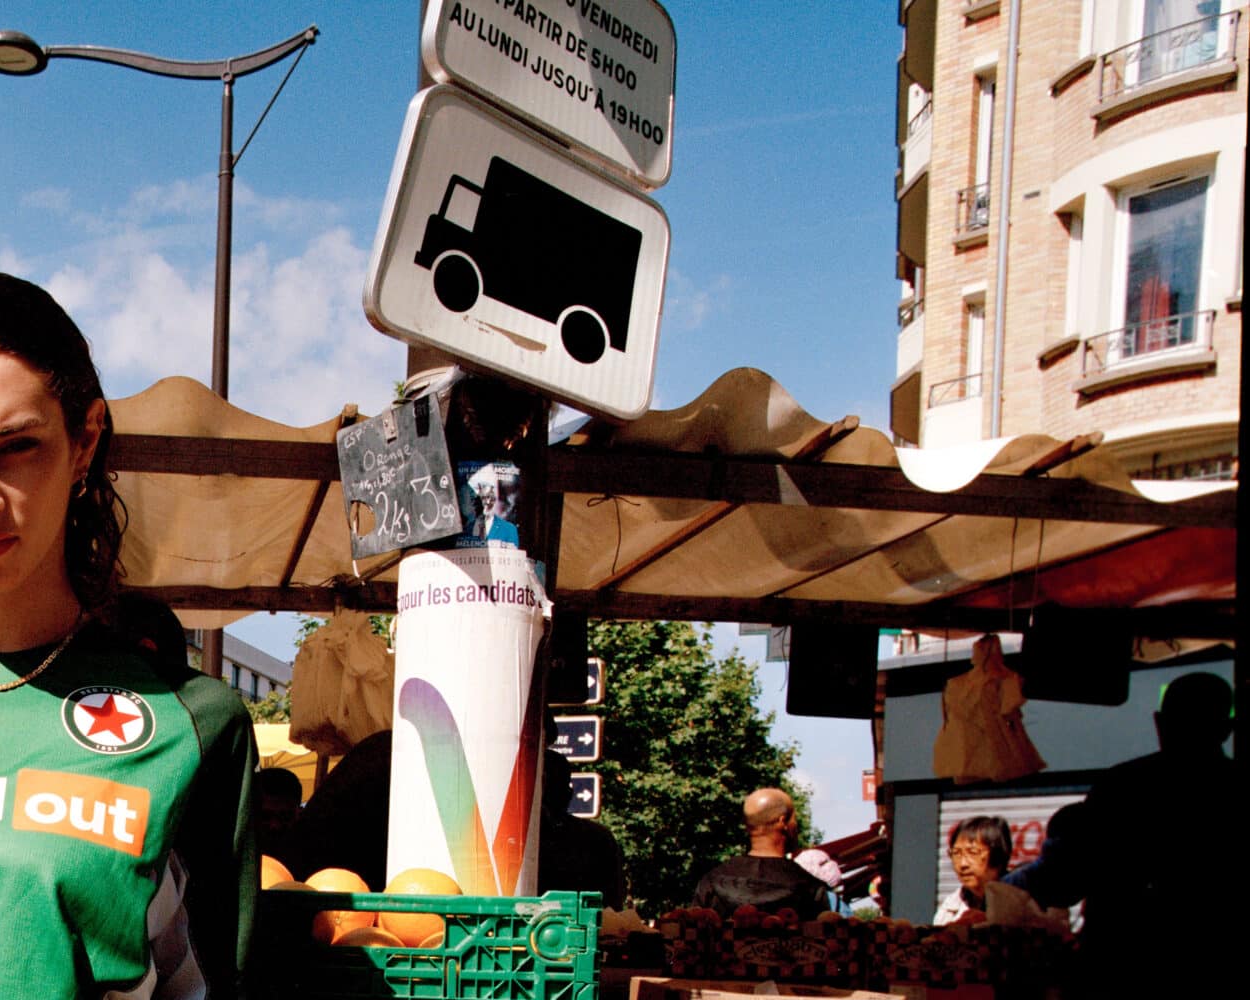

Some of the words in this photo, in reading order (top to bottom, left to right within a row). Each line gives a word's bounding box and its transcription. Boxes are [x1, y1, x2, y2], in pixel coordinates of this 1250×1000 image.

[565, 31, 587, 61] DE
[579, 0, 658, 64] VENDREDI
[450, 2, 476, 32] AU
[477, 18, 529, 68] LUNDI
[594, 87, 606, 114] À
[609, 100, 664, 146] 19H00
[428, 583, 451, 606] les
[456, 580, 536, 607] candidats
[23, 791, 138, 844] out
